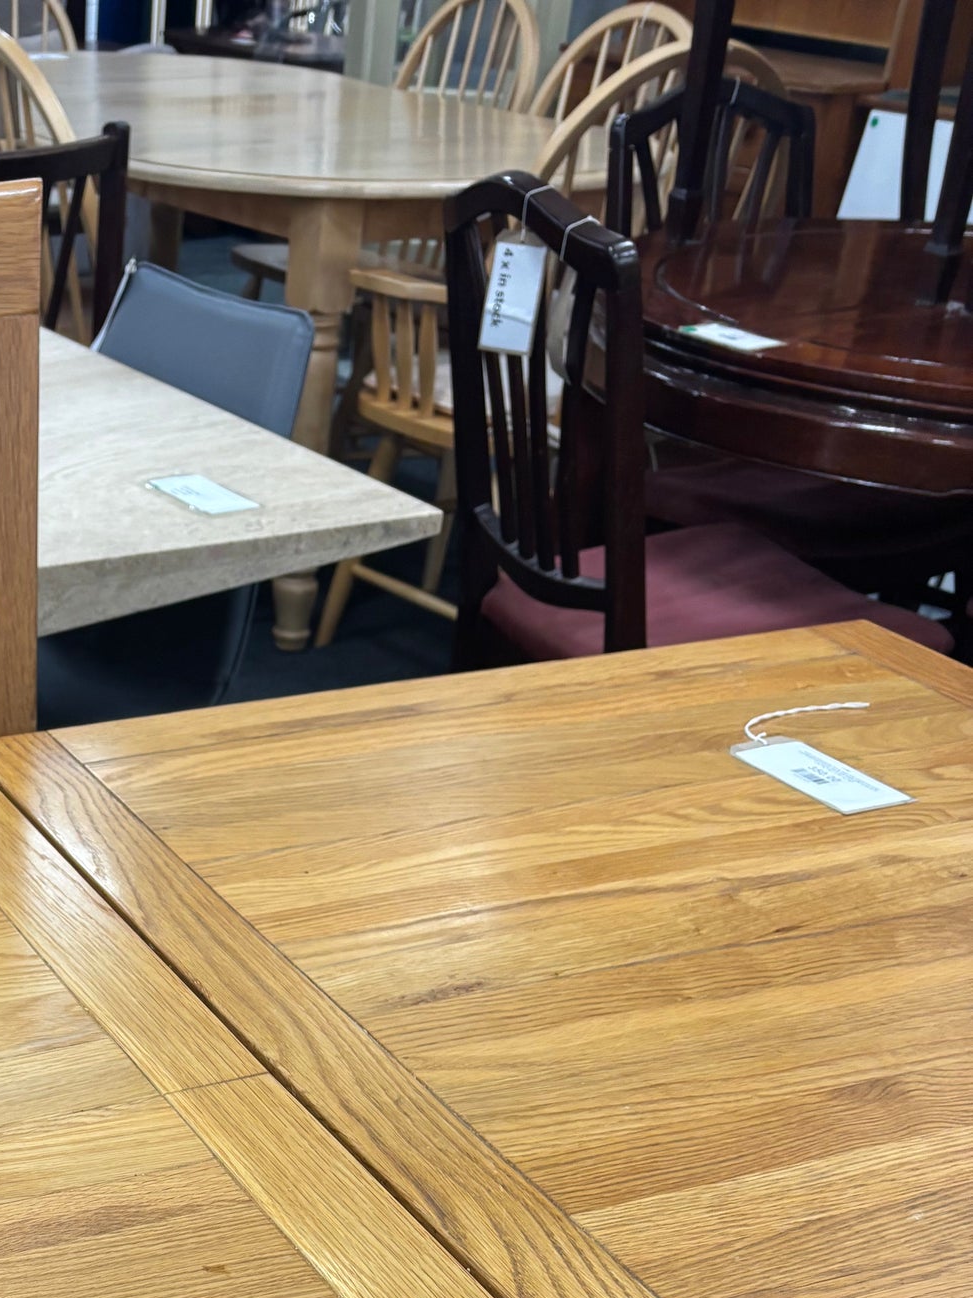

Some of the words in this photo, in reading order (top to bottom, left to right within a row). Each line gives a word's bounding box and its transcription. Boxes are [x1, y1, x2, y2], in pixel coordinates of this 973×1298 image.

[504, 247, 514, 257] 4
[497, 272, 512, 287] in
[490, 290, 505, 328] stock
